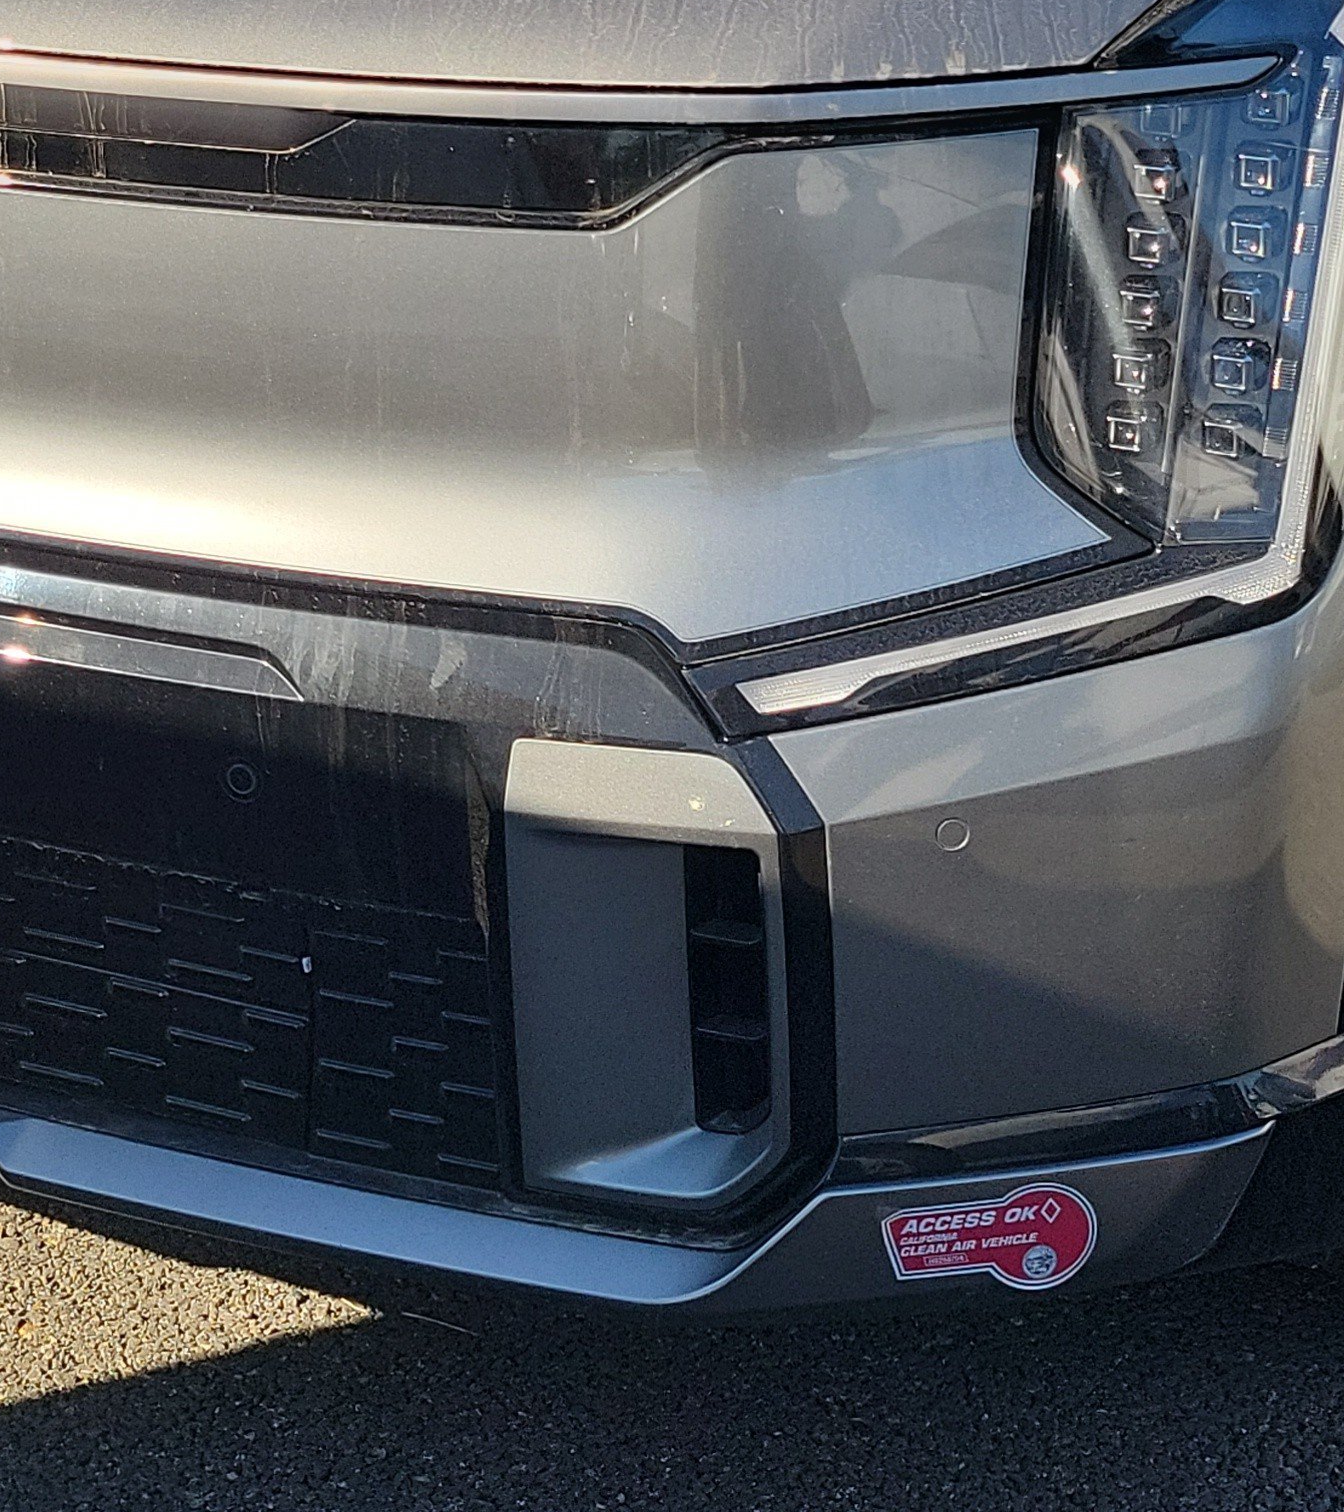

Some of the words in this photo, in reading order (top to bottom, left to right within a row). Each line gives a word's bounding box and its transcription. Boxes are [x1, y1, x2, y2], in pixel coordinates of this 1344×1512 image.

[900, 1211, 997, 1235] ACCESS
[1004, 1205, 1039, 1223] OK
[900, 1243, 948, 1257] CLEAN
[951, 1239, 977, 1252] AIR
[981, 1232, 1039, 1249] VEHICLE
